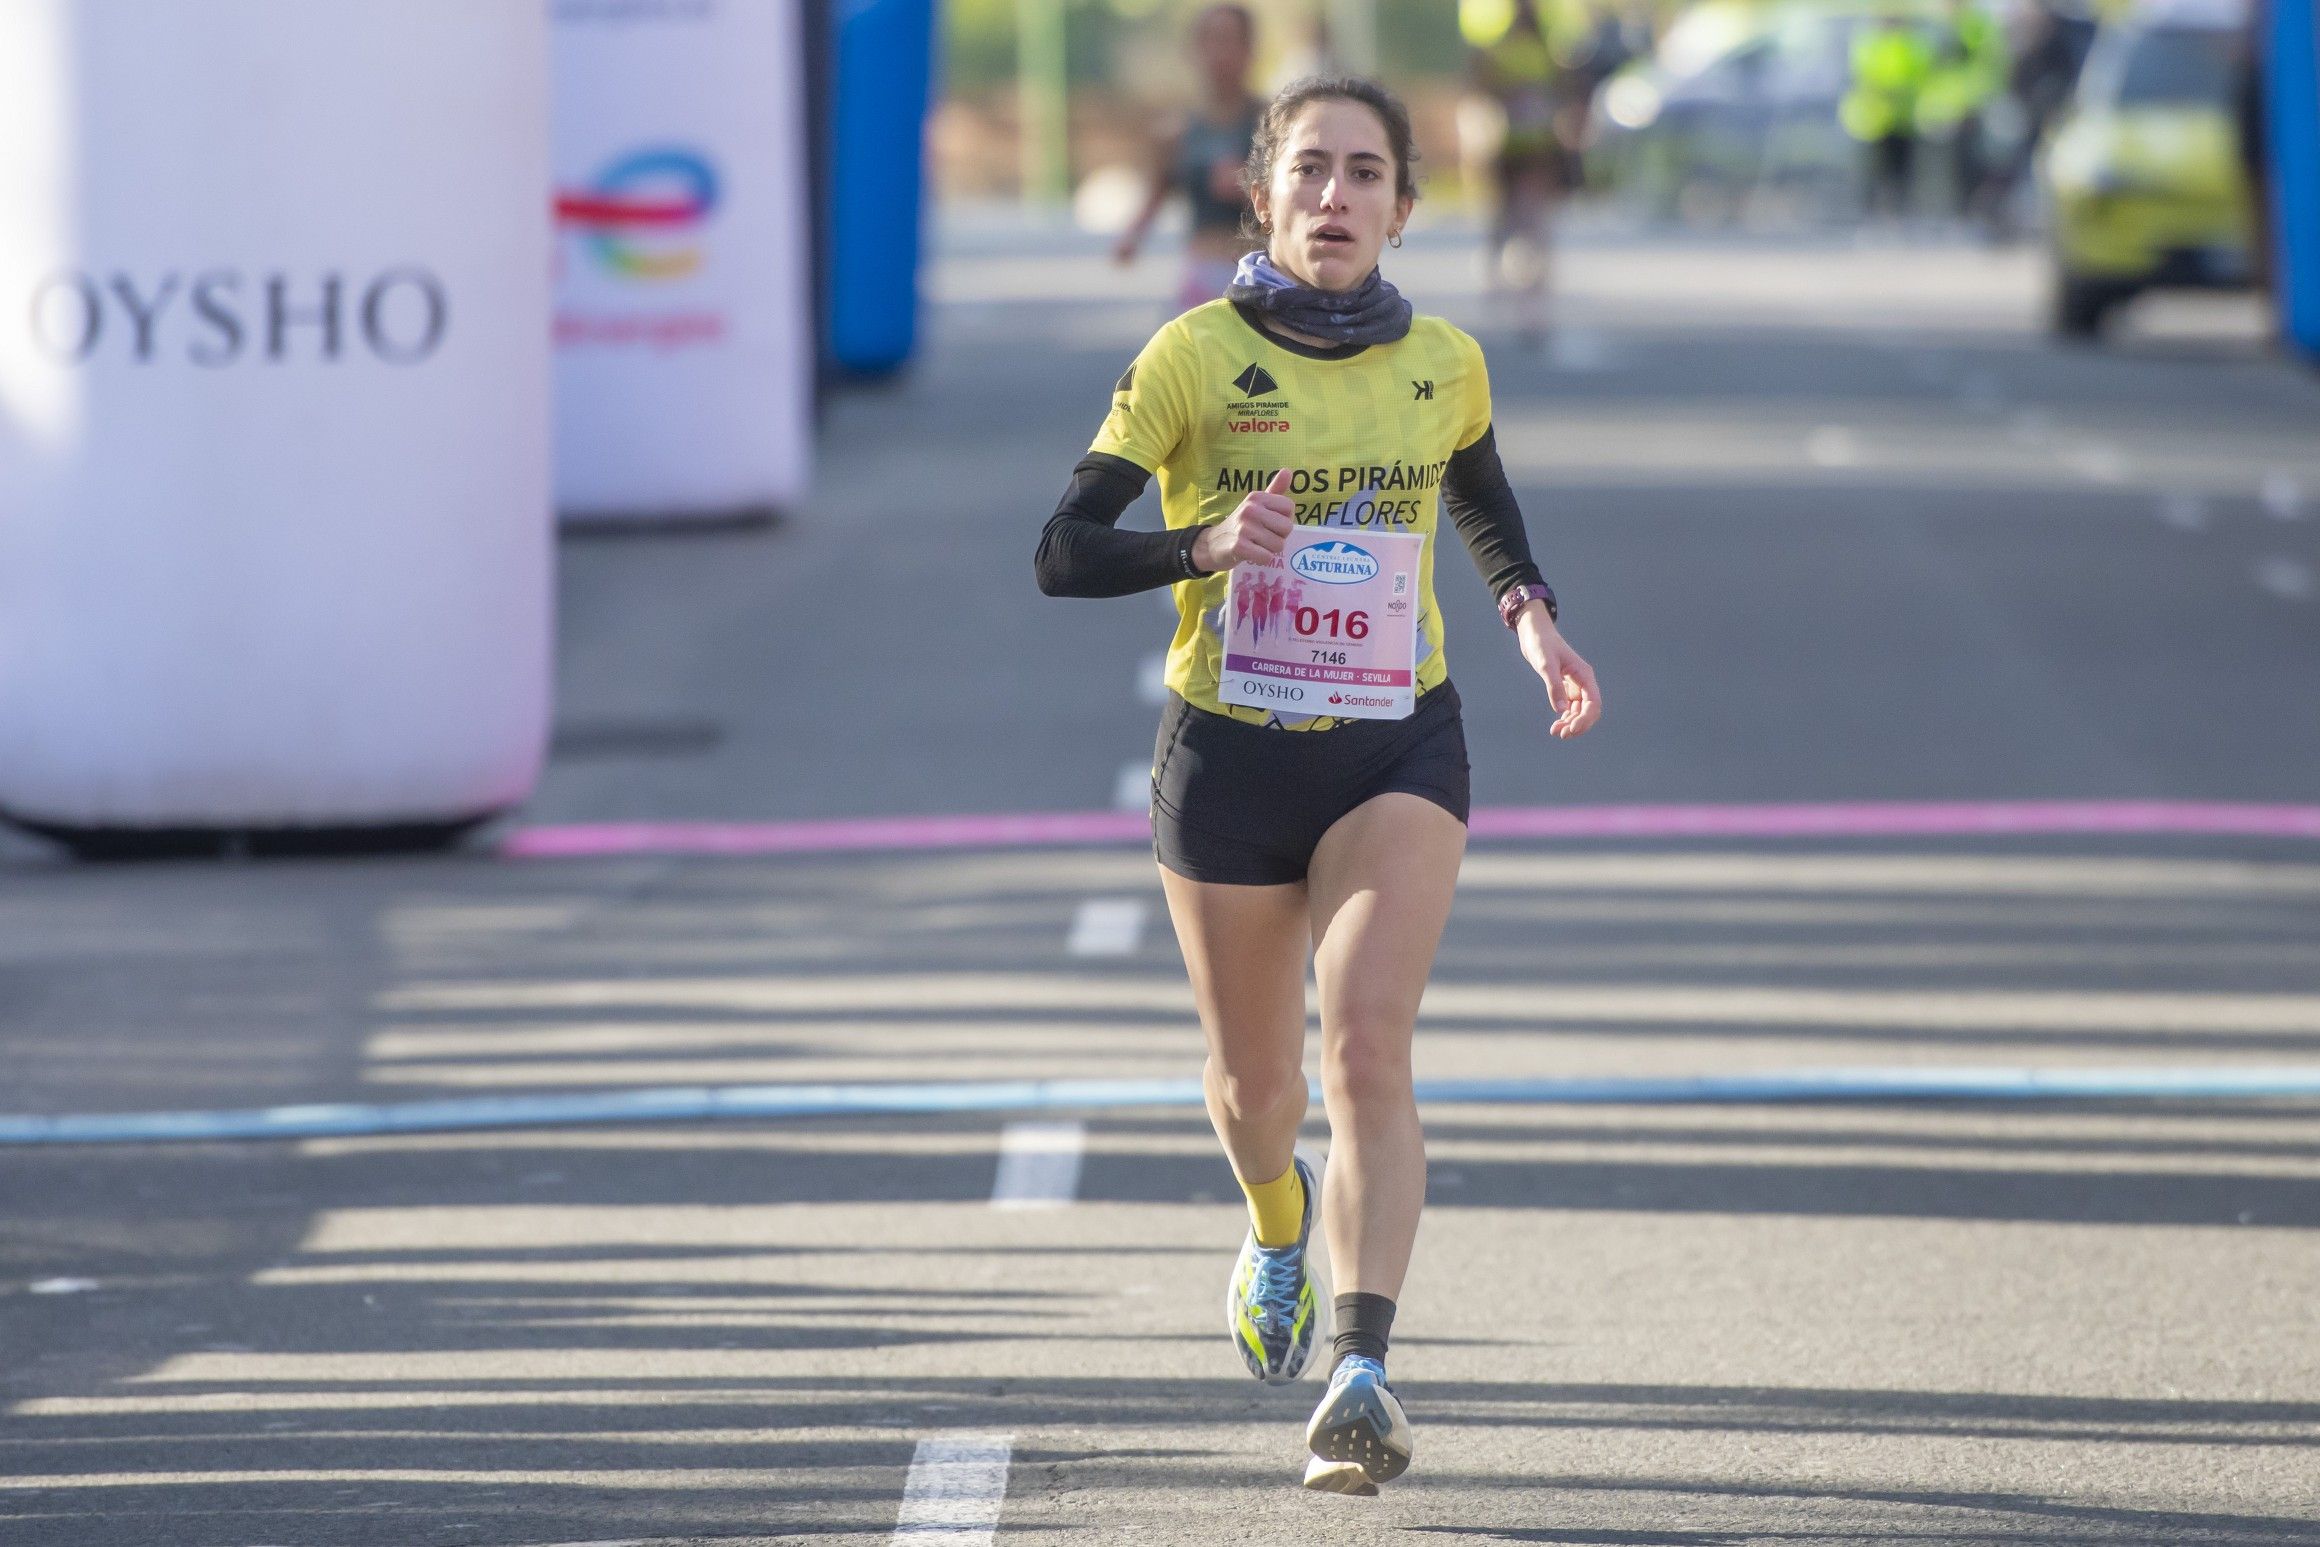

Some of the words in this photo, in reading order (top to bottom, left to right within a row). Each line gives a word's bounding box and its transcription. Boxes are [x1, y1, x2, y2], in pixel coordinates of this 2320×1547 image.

[30, 265, 447, 367] OYSHO
[1227, 402, 1255, 410] AMIGOS
[1228, 418, 1290, 433] valora
[1293, 500, 1421, 526] RAFLORES
[1297, 554, 1372, 575] ASTURIANA
[1294, 606, 1369, 640] 016
[1311, 650, 1346, 665] 7146
[1252, 661, 1292, 676] CARRERA
[1295, 667, 1306, 677] DE
[1309, 669, 1320, 679] LA
[1324, 670, 1354, 681] MUJER
[1362, 672, 1391, 683] SEVILLA
[1243, 680, 1304, 701] OYSHO
[1344, 694, 1394, 707] Santander
